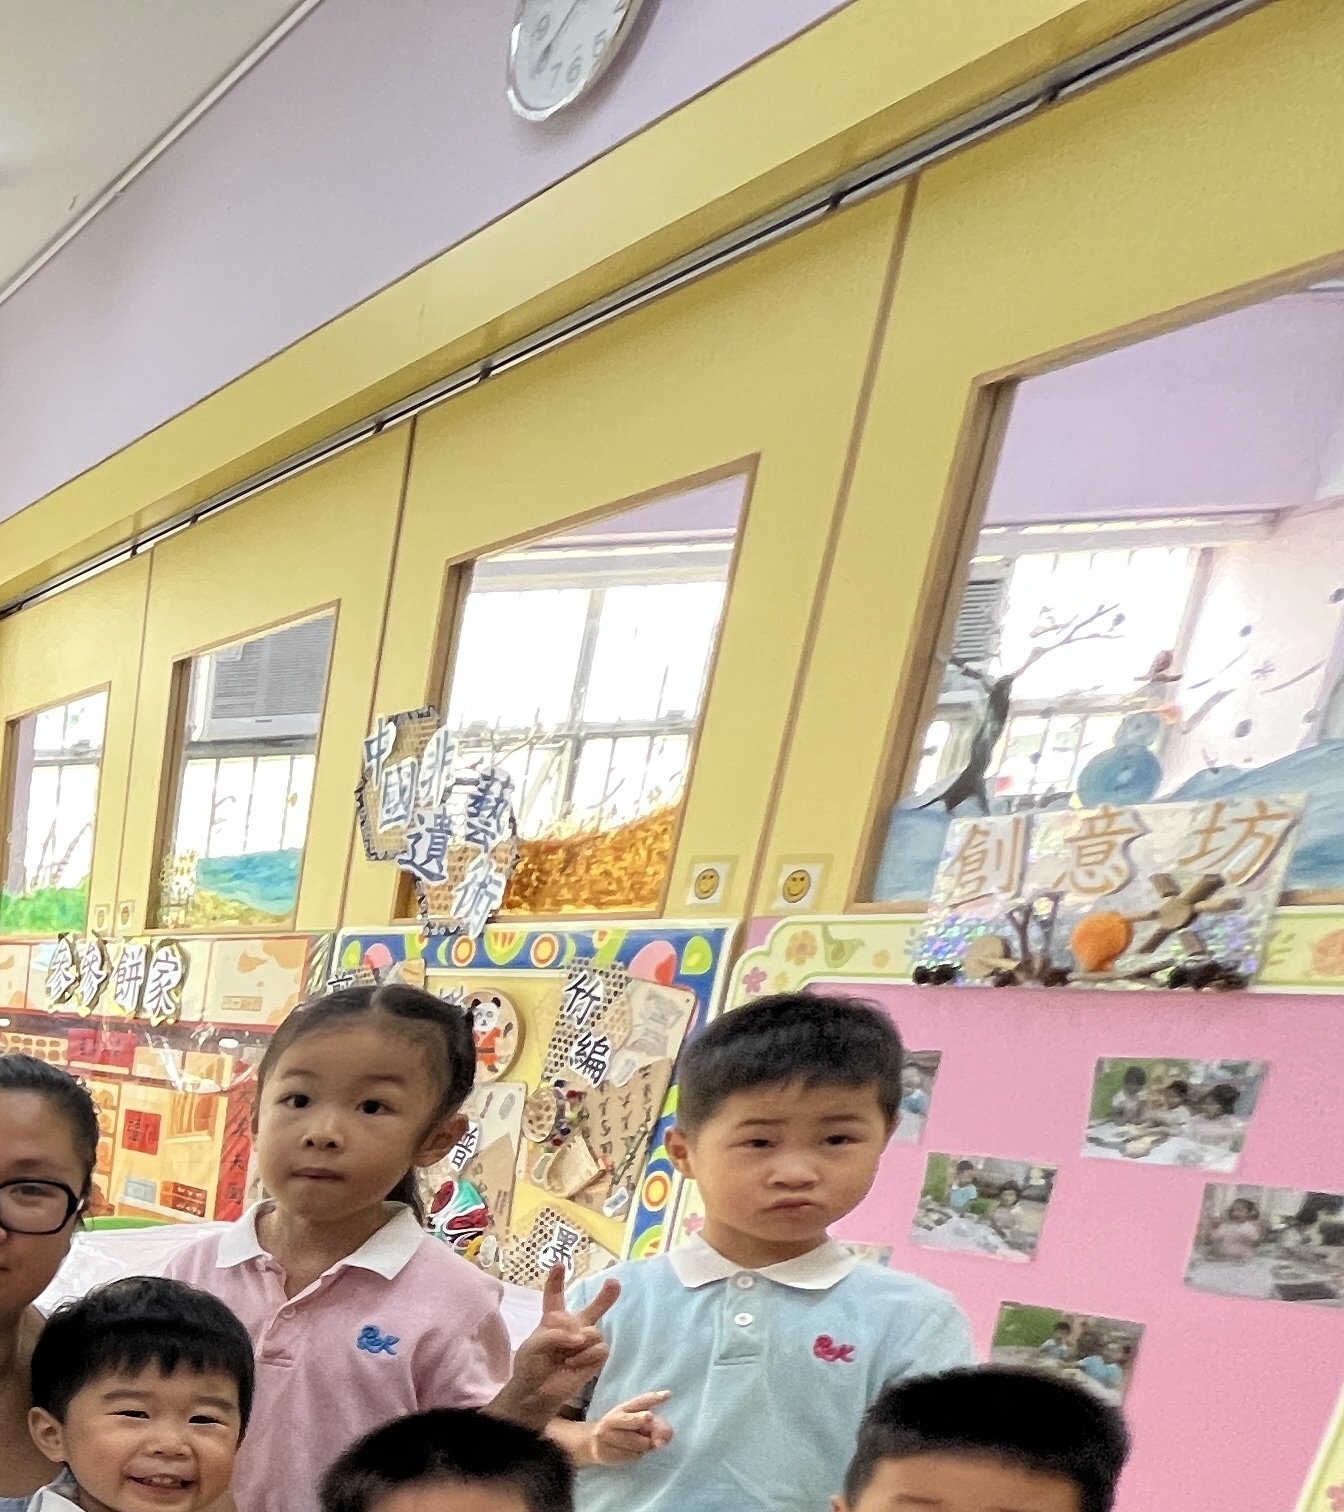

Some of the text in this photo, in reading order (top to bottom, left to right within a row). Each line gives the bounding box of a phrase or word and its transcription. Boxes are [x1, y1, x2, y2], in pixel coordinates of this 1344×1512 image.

[949, 801, 1292, 906] 創意坊
[566, 972, 609, 1083] 竹編
